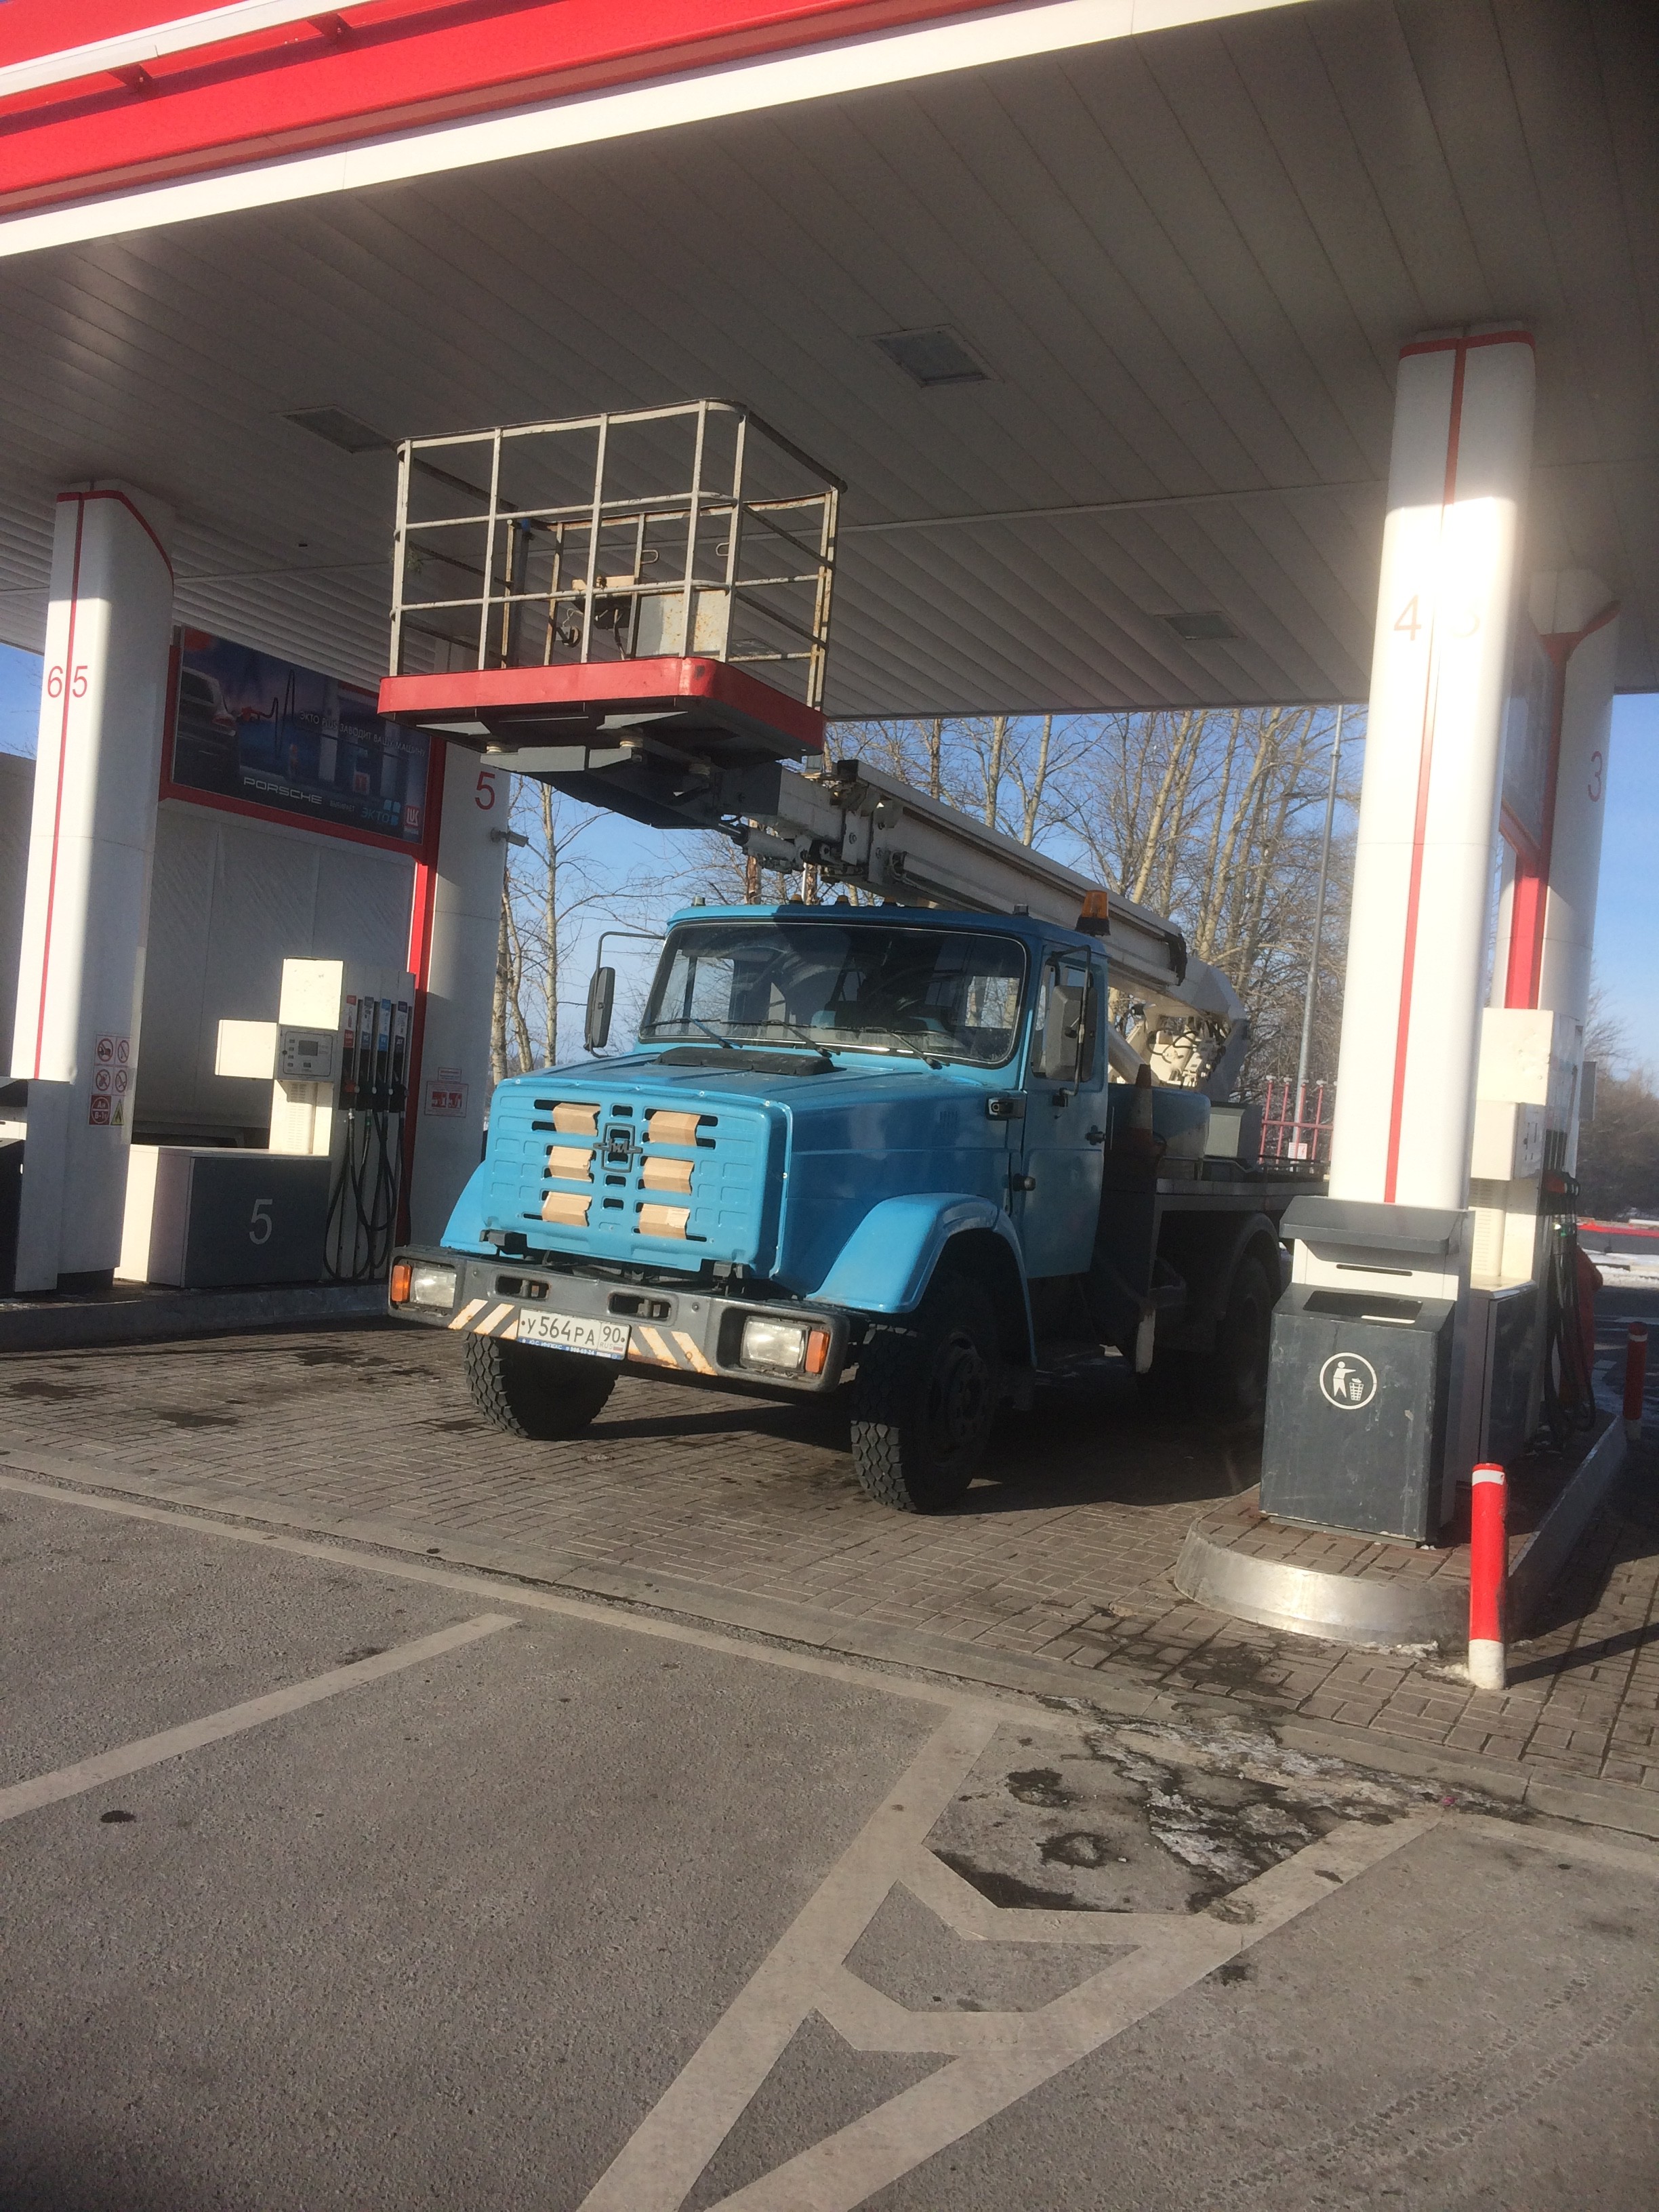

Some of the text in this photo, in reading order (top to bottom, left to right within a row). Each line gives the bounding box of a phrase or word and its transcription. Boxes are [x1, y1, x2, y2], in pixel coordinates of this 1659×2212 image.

[1393, 594, 1422, 641] 4
[47, 665, 63, 698] 6
[73, 665, 88, 698] 5
[300, 711, 320, 724] ЭКТО
[340, 723, 372, 740] ЗАВОДИТ
[243, 777, 323, 805] PORSCHE
[475, 771, 495, 810] 5
[1588, 751, 1603, 802] 3
[361, 806, 390, 823] ЭКТО
[249, 1198, 273, 1244] 5
[600, 1341, 613, 1350] RUS
[602, 1326, 621, 1343] 90
